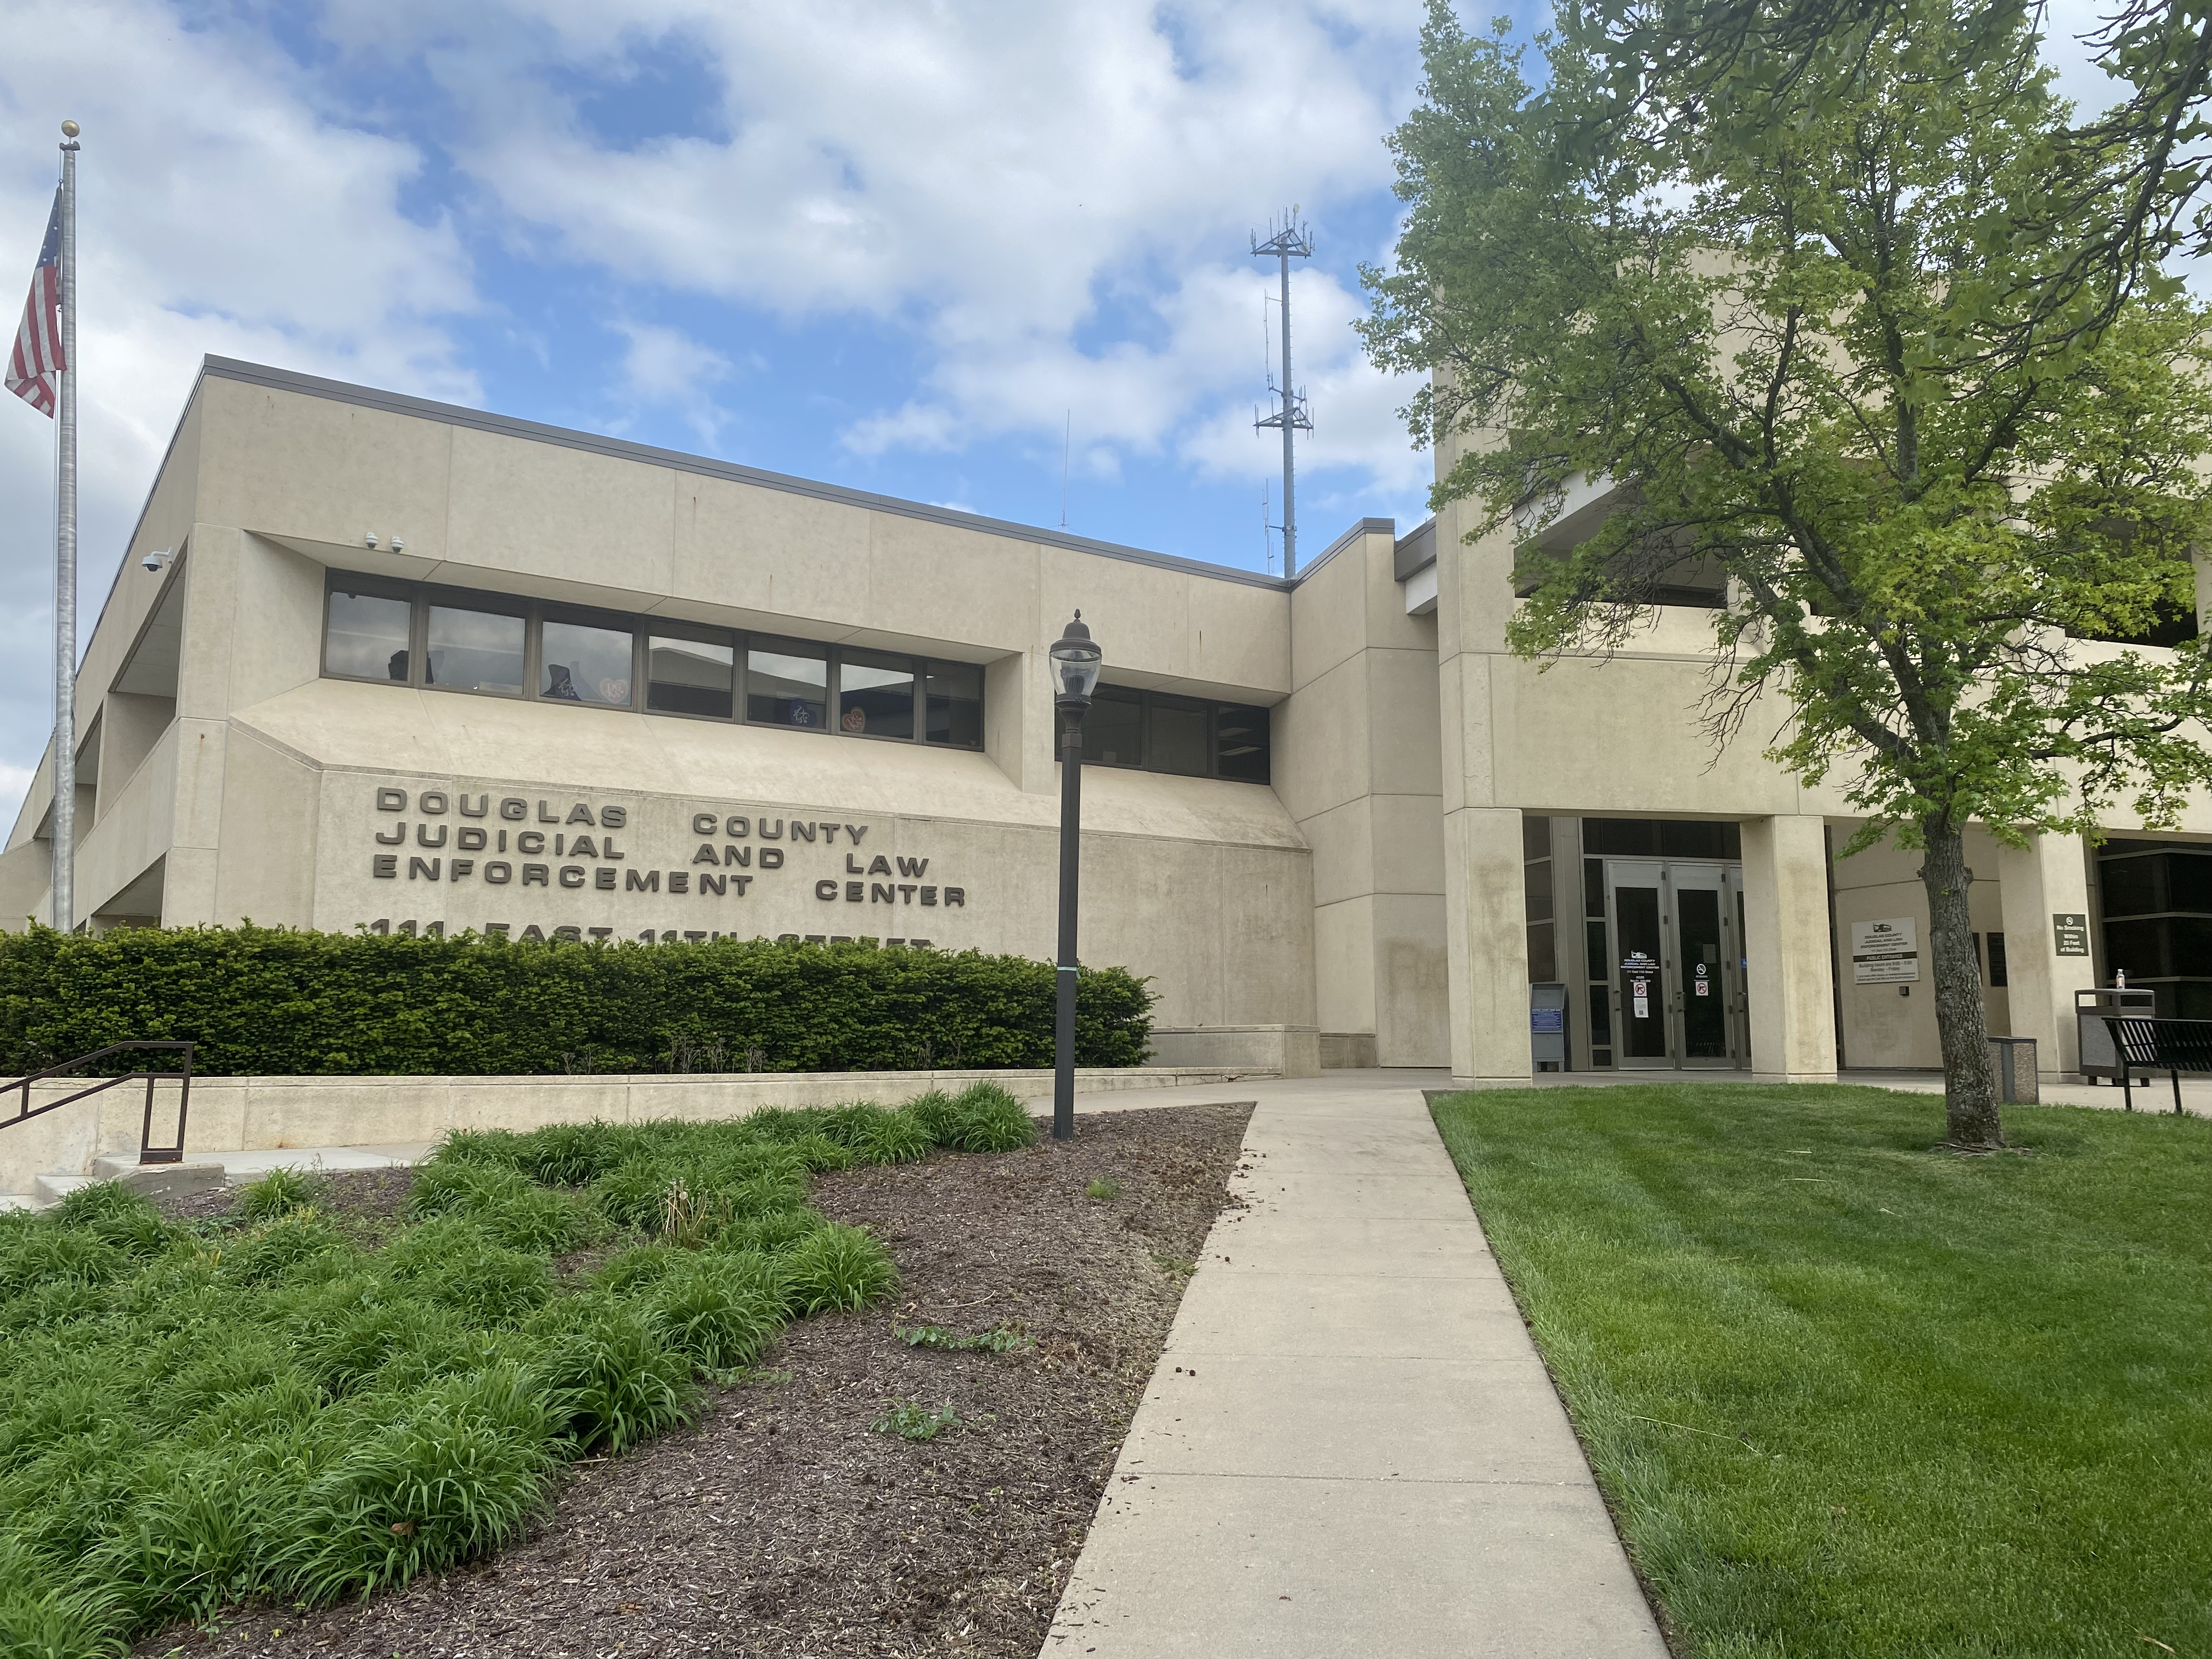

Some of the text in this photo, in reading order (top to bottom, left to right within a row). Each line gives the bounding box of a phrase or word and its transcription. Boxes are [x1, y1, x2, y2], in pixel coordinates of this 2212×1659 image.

[377, 787, 868, 844] DOUGLAS COUNTY
[376, 822, 929, 877] JUDICIAL AND LAW
[374, 854, 964, 906] ENFORCEMENT CENTER
